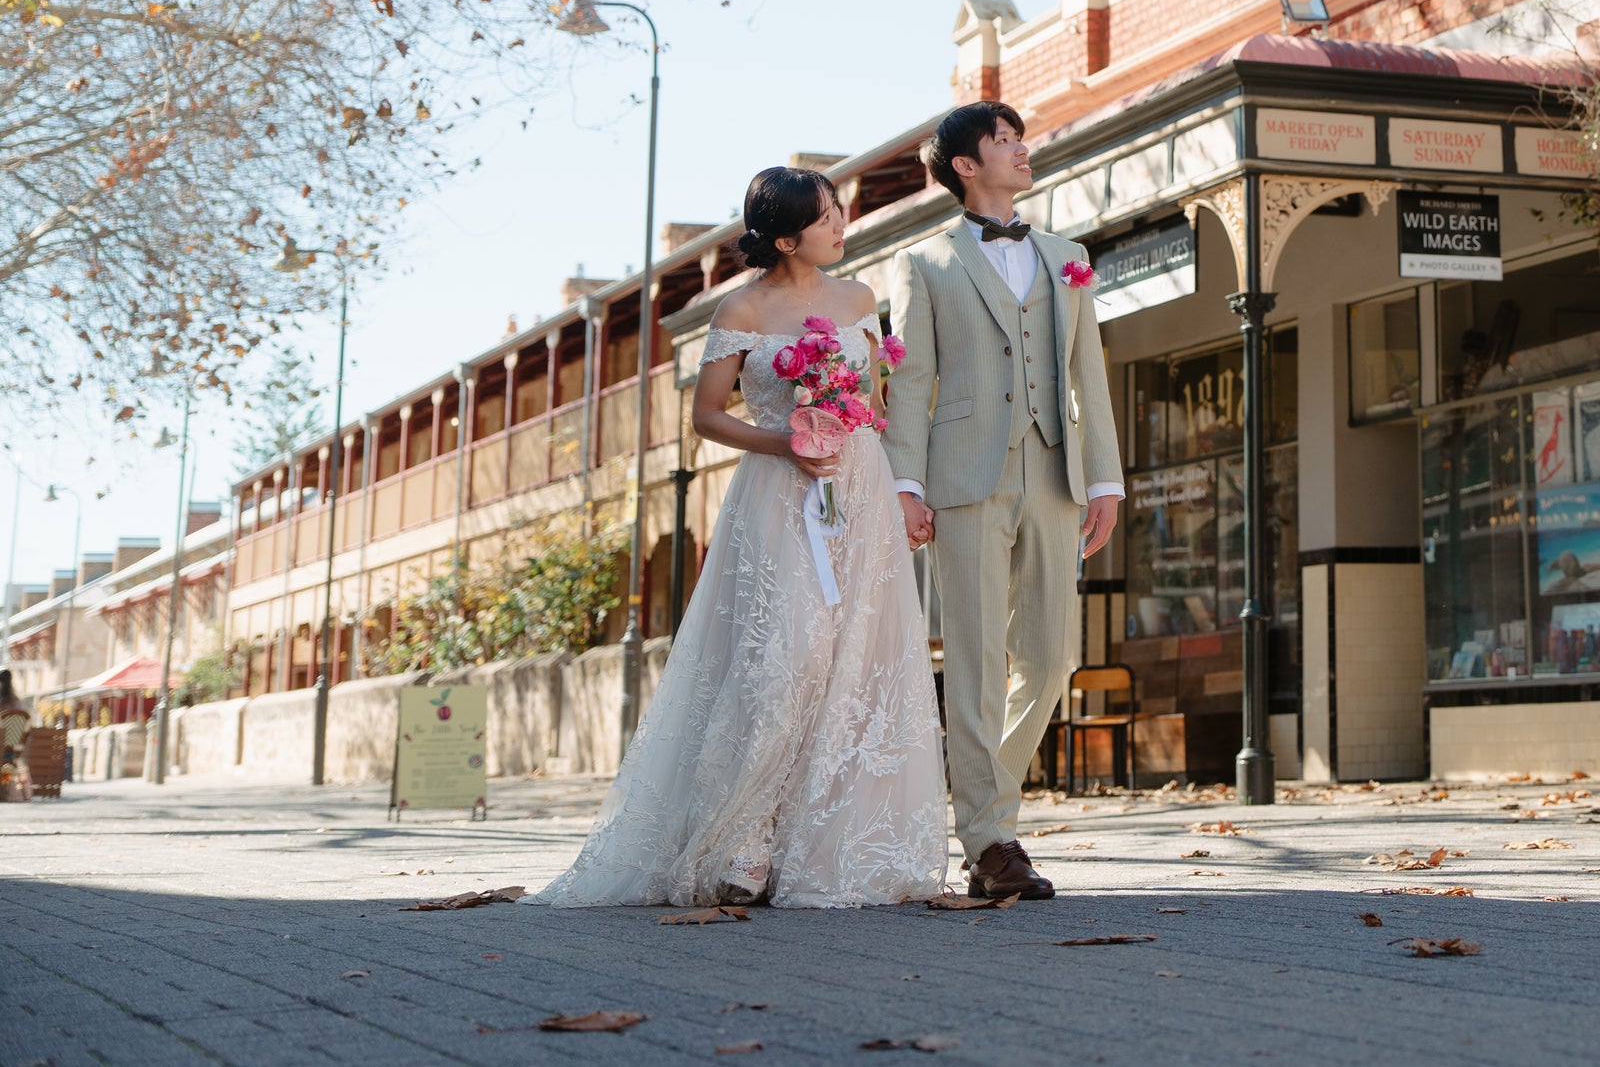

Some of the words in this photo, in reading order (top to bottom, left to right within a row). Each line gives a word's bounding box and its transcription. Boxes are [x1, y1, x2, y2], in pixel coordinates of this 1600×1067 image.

[1265, 120, 1325, 136] MARKET
[1328, 124, 1364, 139] OPEN
[1289, 137, 1339, 152] FRIDAY
[1403, 129, 1485, 149] SATURDAY
[1537, 138, 1588, 156] HOLIDA
[1414, 148, 1476, 165] SUNDAY
[1538, 156, 1597, 173] MONDAY
[1403, 212, 1445, 230] WILD
[1449, 214, 1498, 232] EARTH
[1423, 233, 1481, 251] IMAGES
[1116, 252, 1149, 282] EARTH
[1150, 237, 1189, 270] IMAGES
[1420, 262, 1450, 271] PHOTO
[1450, 262, 1487, 272] GALLERY
